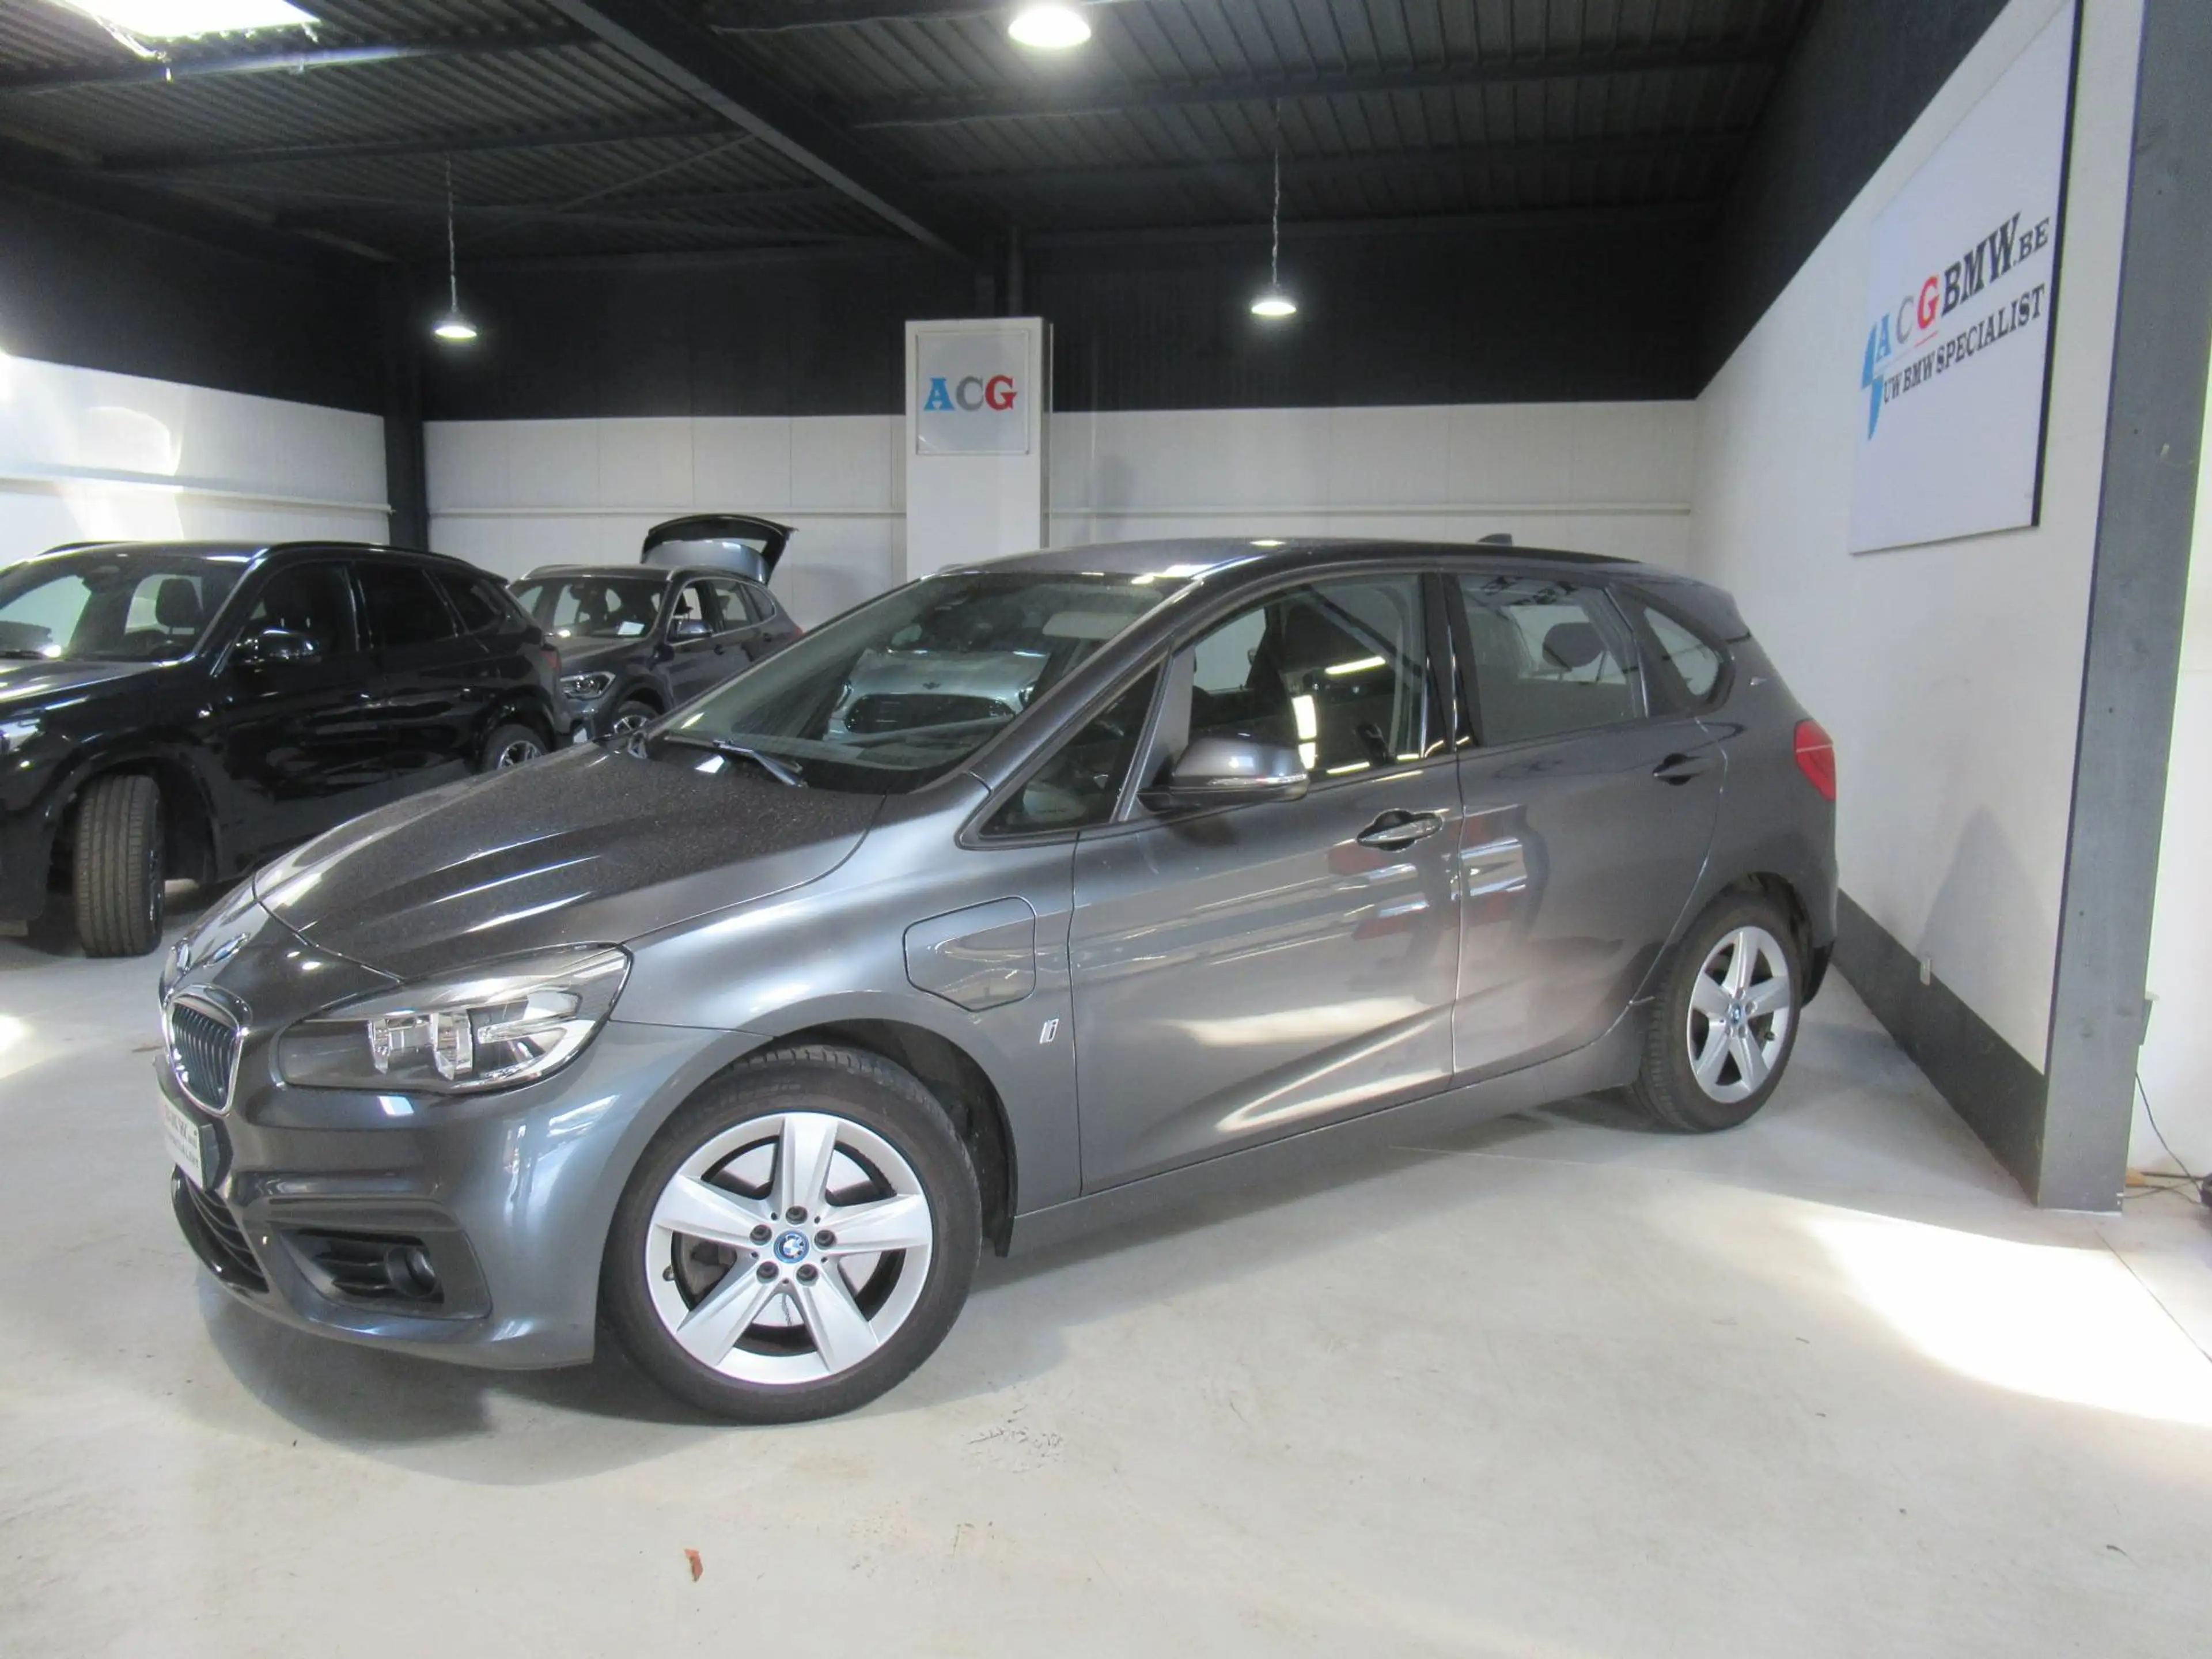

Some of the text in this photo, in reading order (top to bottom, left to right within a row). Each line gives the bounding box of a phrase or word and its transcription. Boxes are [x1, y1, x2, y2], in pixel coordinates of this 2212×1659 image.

[1883, 282, 2045, 404] UW BMW SPECIALIST
[923, 374, 1018, 412] ACG
